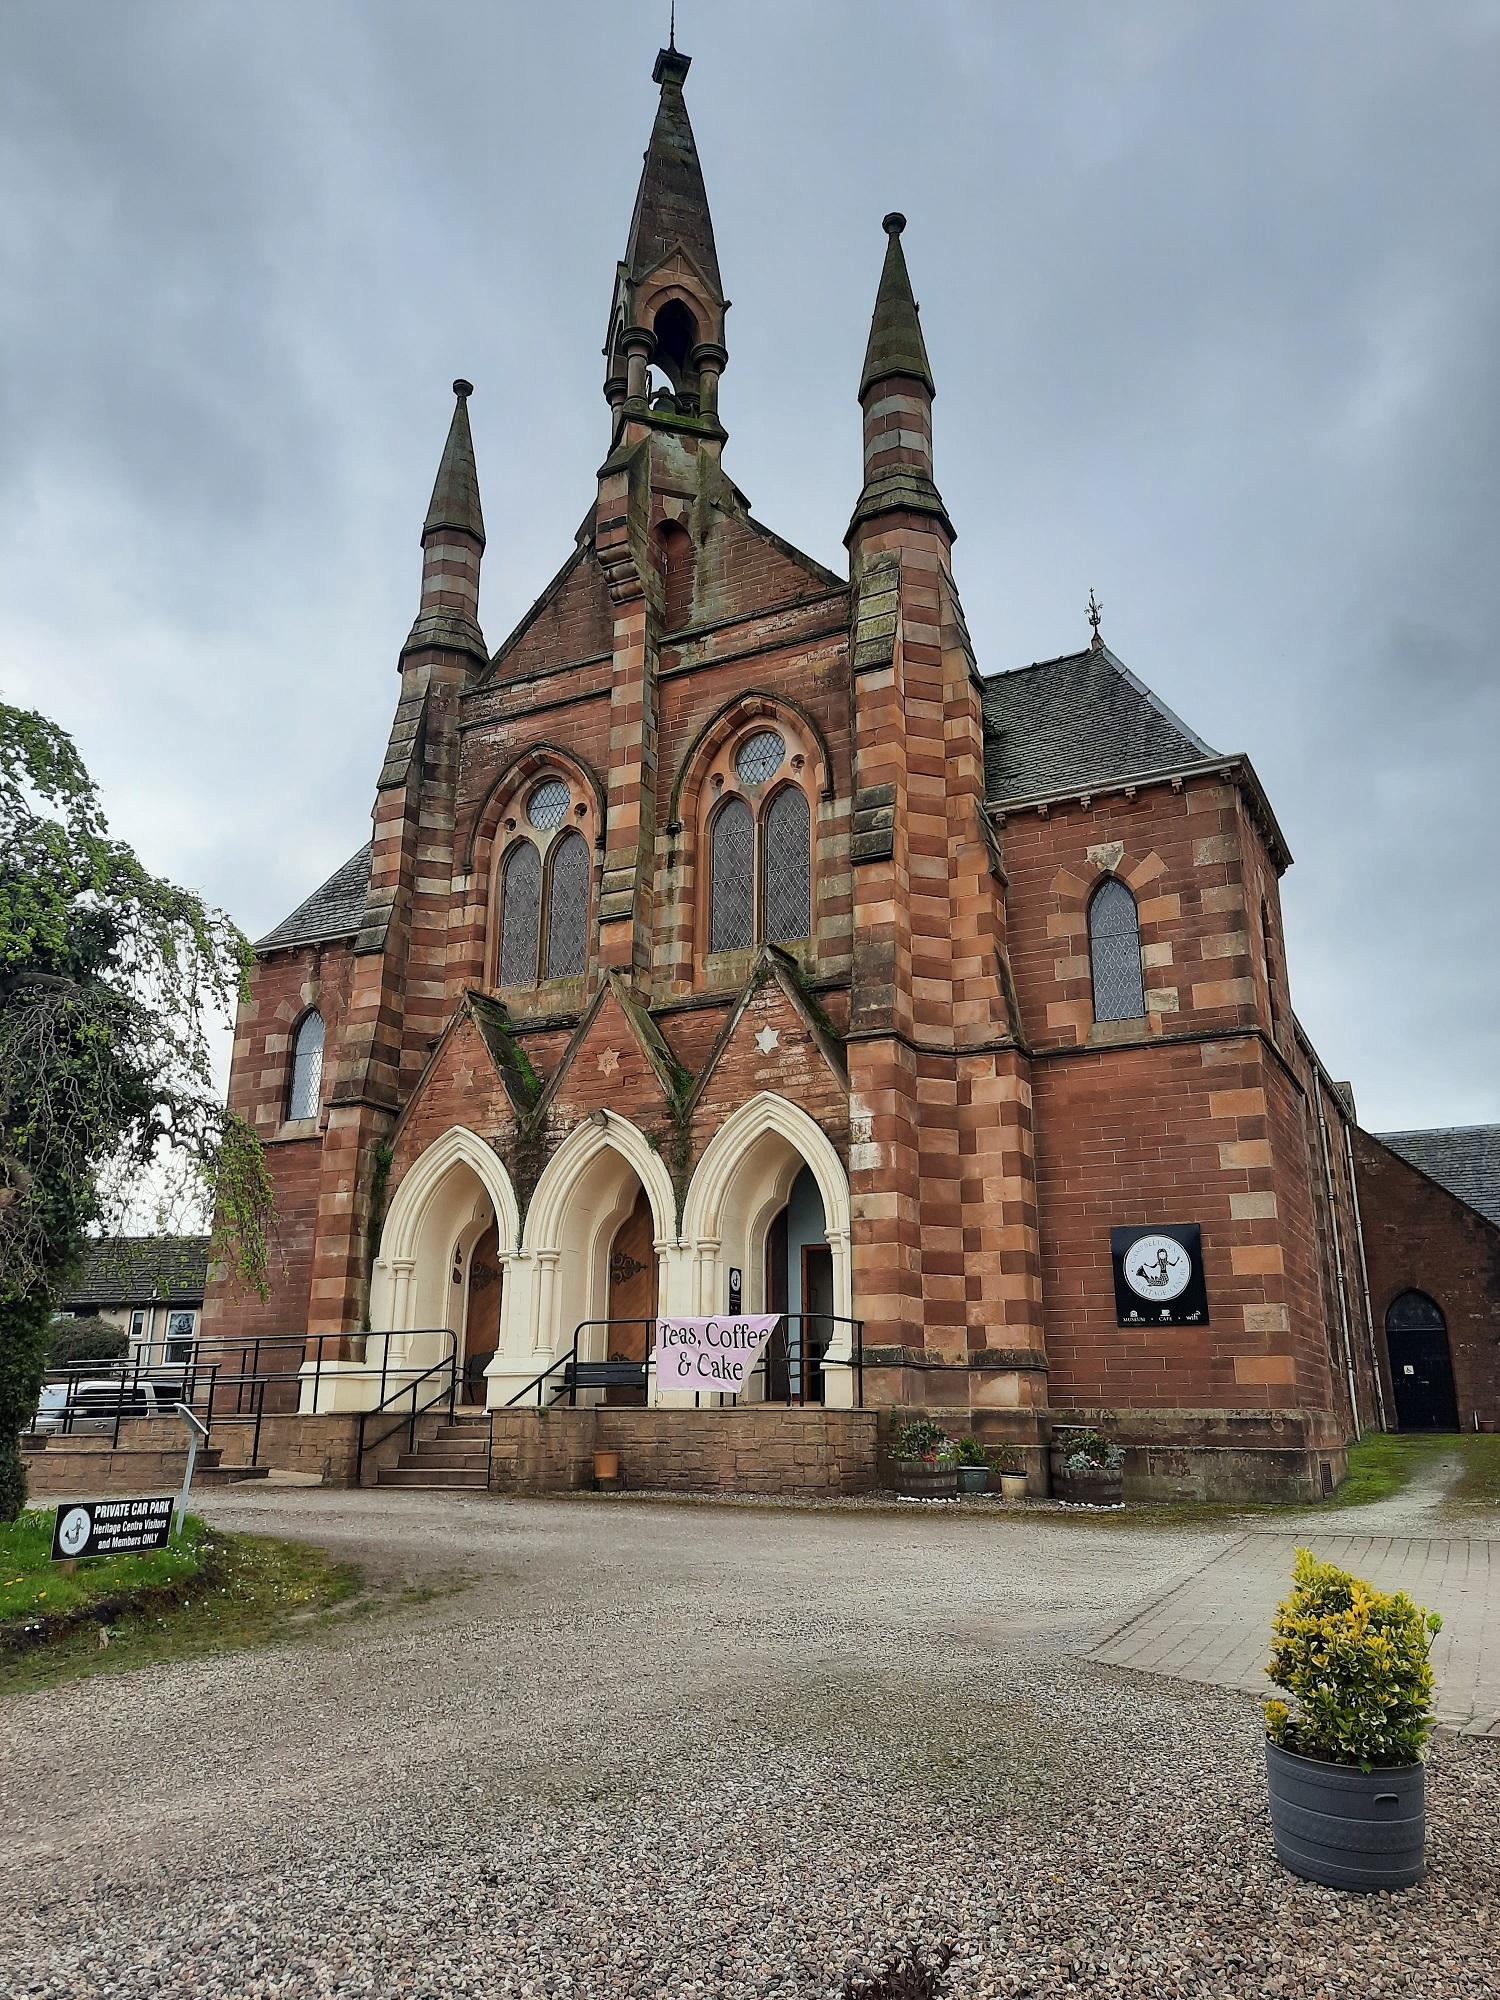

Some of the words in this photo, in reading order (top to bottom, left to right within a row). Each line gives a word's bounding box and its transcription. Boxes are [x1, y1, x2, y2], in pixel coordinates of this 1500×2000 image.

[660, 1324, 701, 1350] Teas,
[677, 1351, 692, 1376] &
[697, 1353, 743, 1381] Cake
[94, 1503, 130, 1519] PRIVATE
[131, 1502, 148, 1516] CAR
[149, 1500, 171, 1514] PARK
[93, 1523, 122, 1535] Heritage
[122, 1520, 143, 1532] Centre
[144, 1519, 167, 1530] Visitors
[97, 1539, 111, 1550] and
[111, 1536, 141, 1549] Members
[142, 1532, 160, 1545] ONLY
